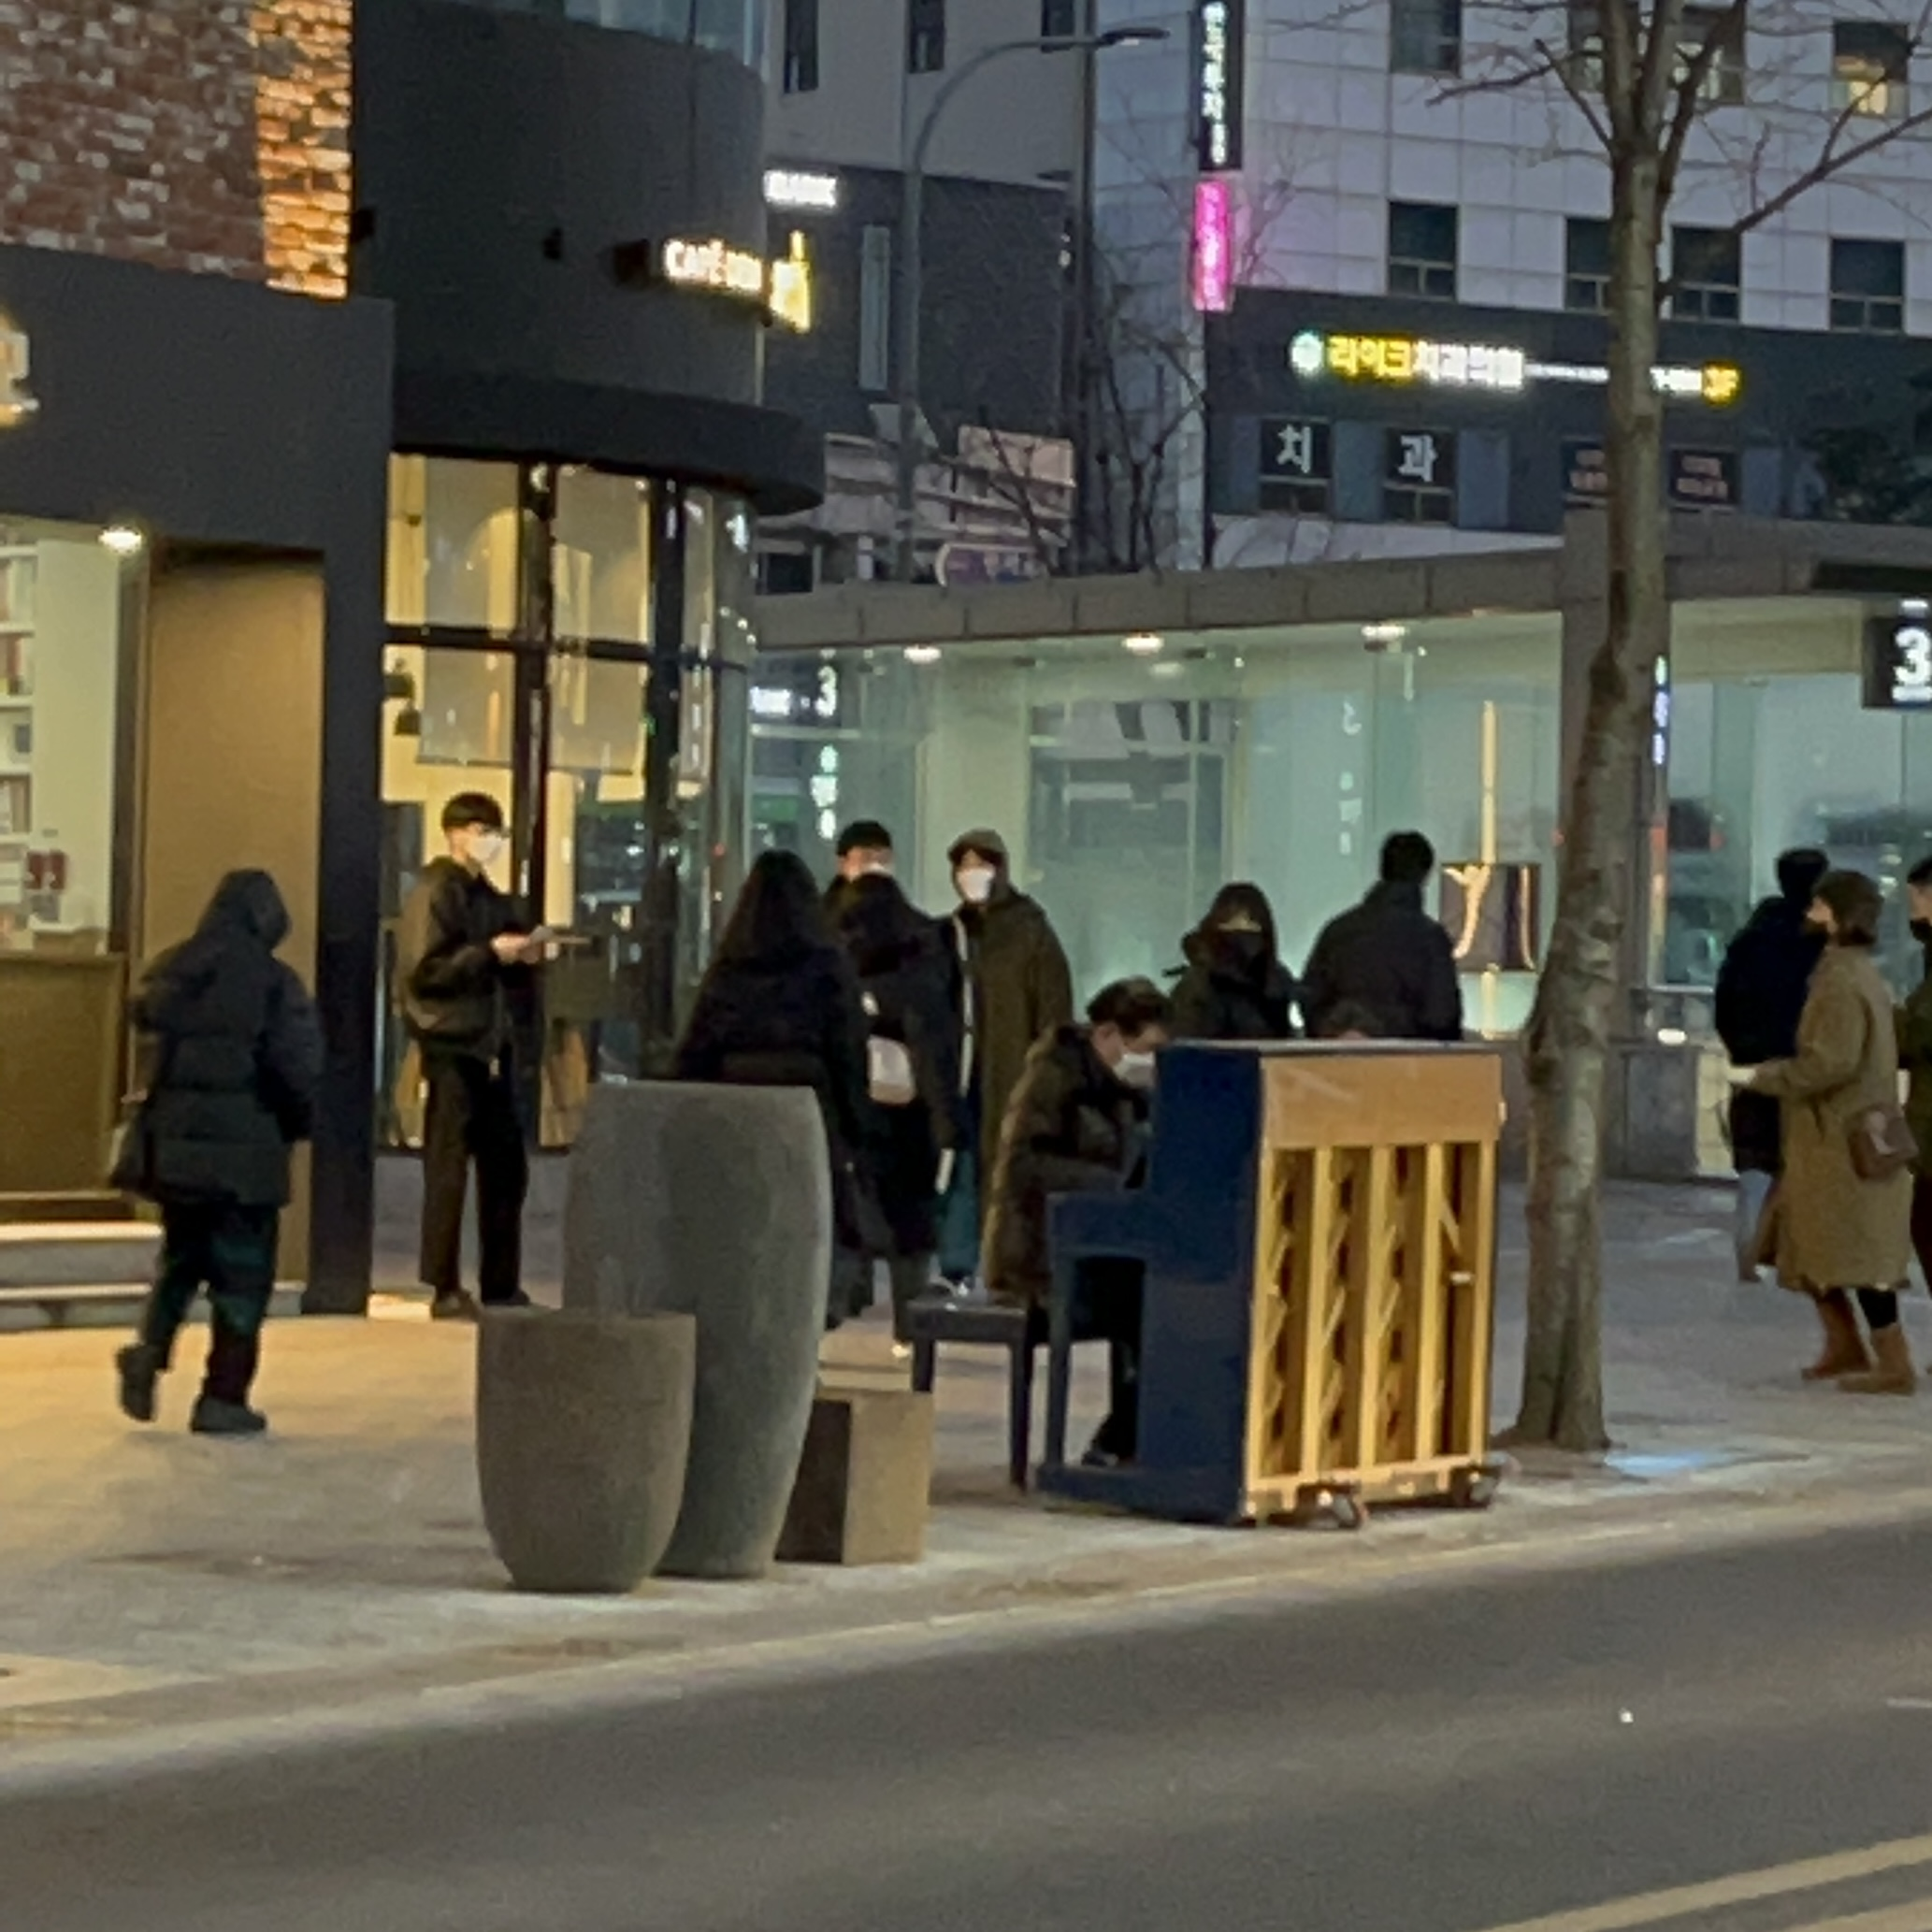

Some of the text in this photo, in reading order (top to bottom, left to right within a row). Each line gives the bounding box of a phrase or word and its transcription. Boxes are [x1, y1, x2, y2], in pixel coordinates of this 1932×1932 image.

[1276, 424, 1438, 483] 치 과
[1893, 627, 1932, 686] 3
[815, 666, 837, 717] 3
